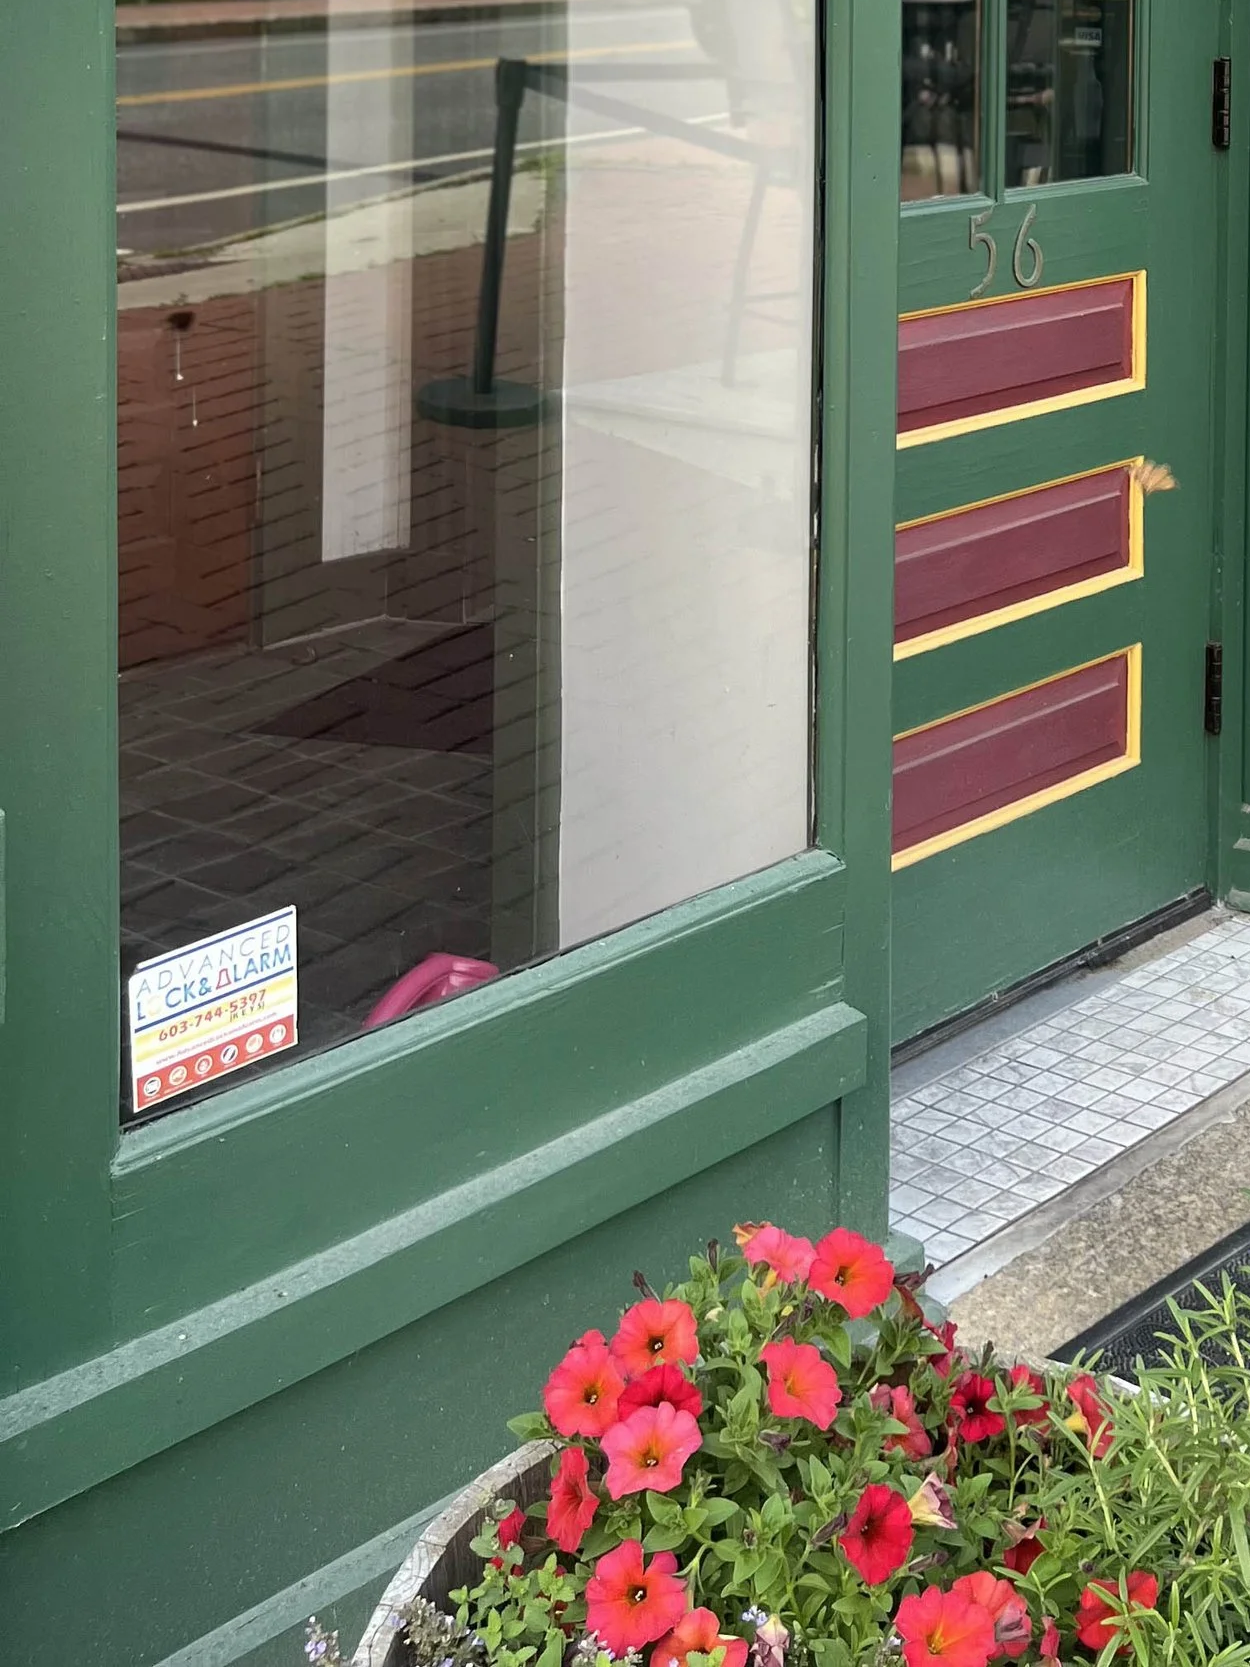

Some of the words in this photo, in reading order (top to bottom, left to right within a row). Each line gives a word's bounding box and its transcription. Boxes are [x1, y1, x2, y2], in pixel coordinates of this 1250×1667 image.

[968, 203, 1043, 299] 56
[135, 924, 291, 998] ADVANCED
[215, 943, 292, 990] ALARM
[158, 989, 267, 1042] 603-744-5397
